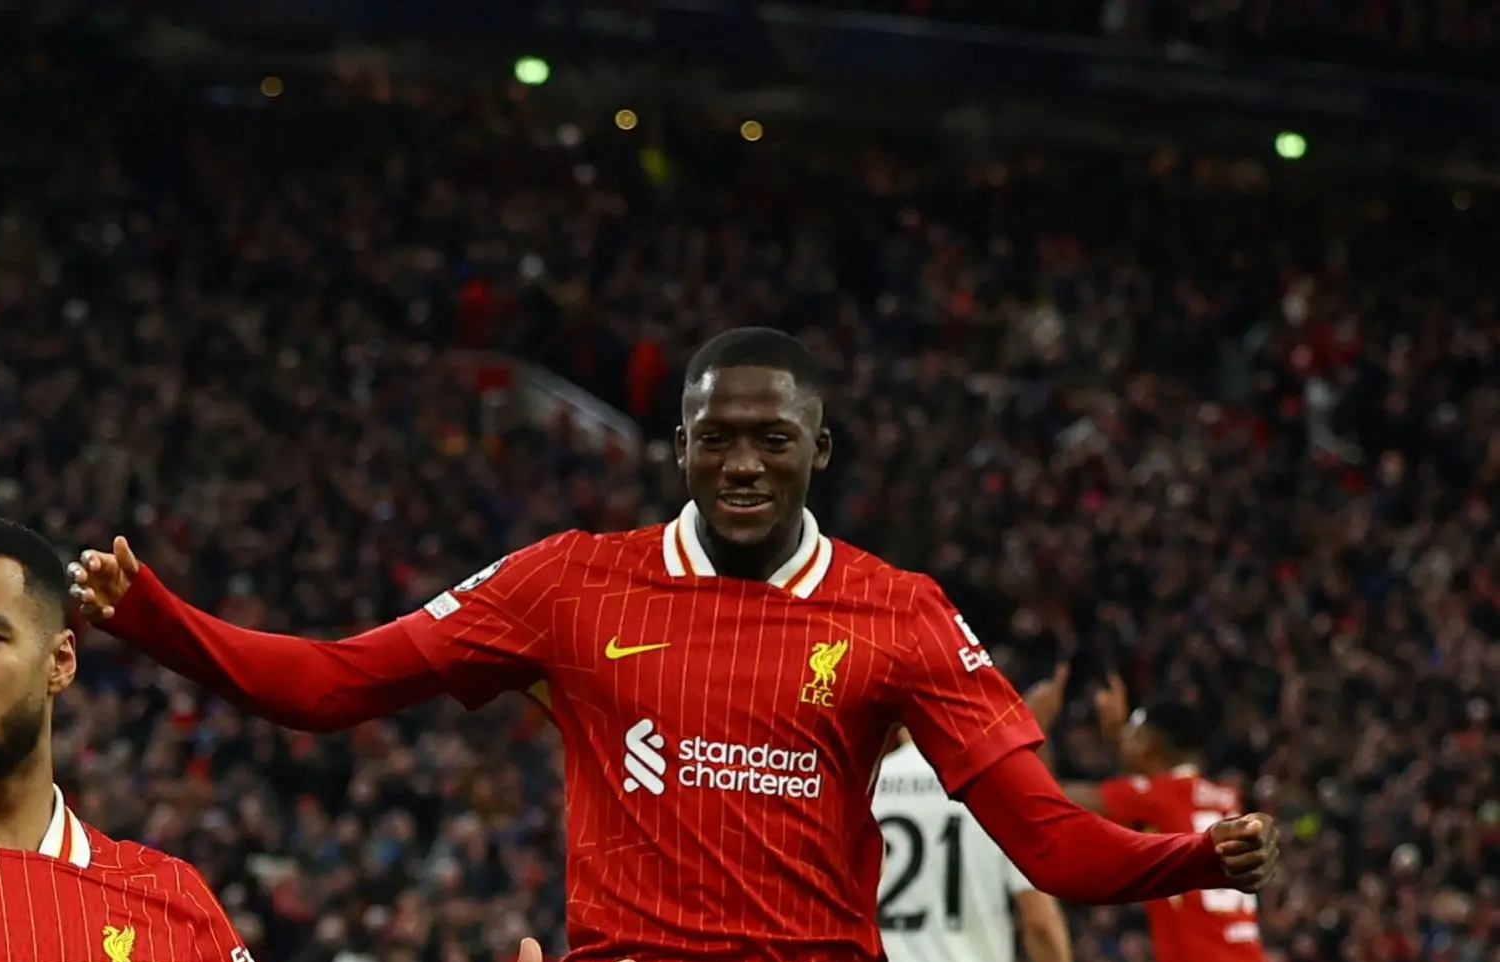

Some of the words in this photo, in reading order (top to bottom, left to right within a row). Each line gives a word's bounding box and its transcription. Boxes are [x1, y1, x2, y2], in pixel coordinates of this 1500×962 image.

[678, 735, 818, 773] standard
[678, 761, 821, 799] chartered
[876, 815, 963, 932] 21
